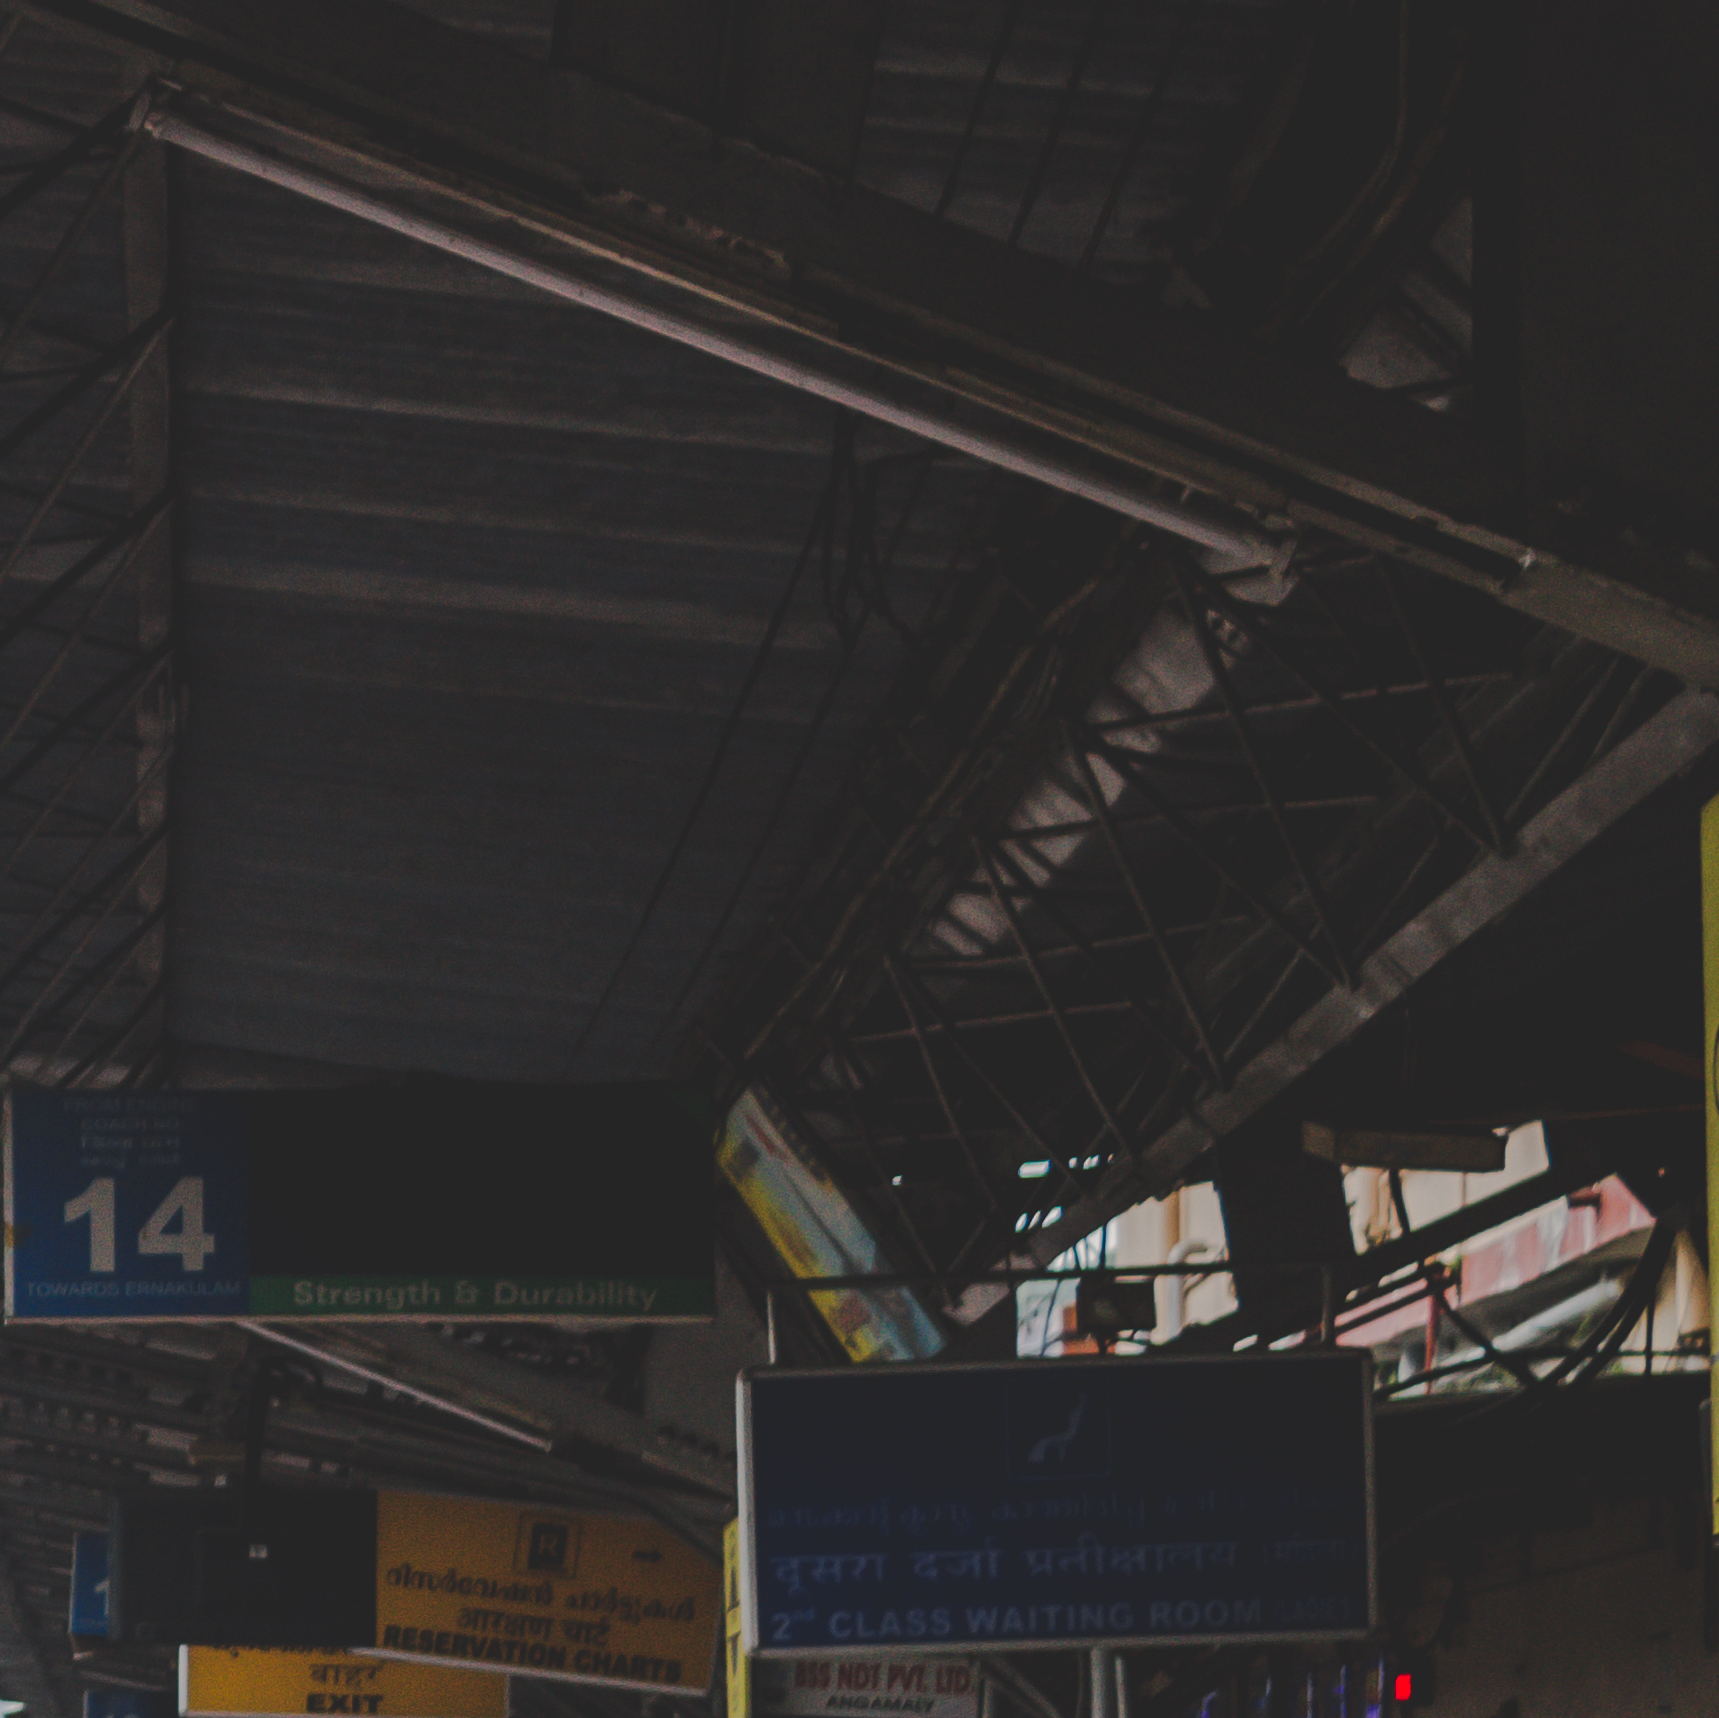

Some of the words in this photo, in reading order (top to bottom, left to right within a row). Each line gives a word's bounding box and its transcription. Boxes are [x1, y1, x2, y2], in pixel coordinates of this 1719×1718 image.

[64, 1176, 215, 1272] 14
[26, 1281, 120, 1297] TOWARDS
[126, 1281, 240, 1296] ERNAKULAM
[292, 1281, 440, 1310] Strength
[454, 1281, 477, 1306] &
[494, 1282, 657, 1312] Durability
[768, 1552, 888, 1598] दूसरा
[909, 1535, 1001, 1580] दर्जा
[1024, 1532, 1239, 1579] प्रतीक्षालय
[95, 1578, 110, 1615] 1
[770, 1609, 815, 1642] 2nd
[828, 1607, 953, 1640] CLASS
[965, 1602, 1135, 1634] WAITING
[1149, 1597, 1261, 1629] ROOM
[384, 1625, 567, 1670] RESERVATION
[574, 1650, 682, 1683] CHARTS
[794, 1660, 831, 1690] BSS
[838, 1661, 880, 1691] NDT
[888, 1663, 929, 1692] PVT.
[306, 1693, 383, 1714] EXIT
[825, 1696, 934, 1712] ANGAMALY
